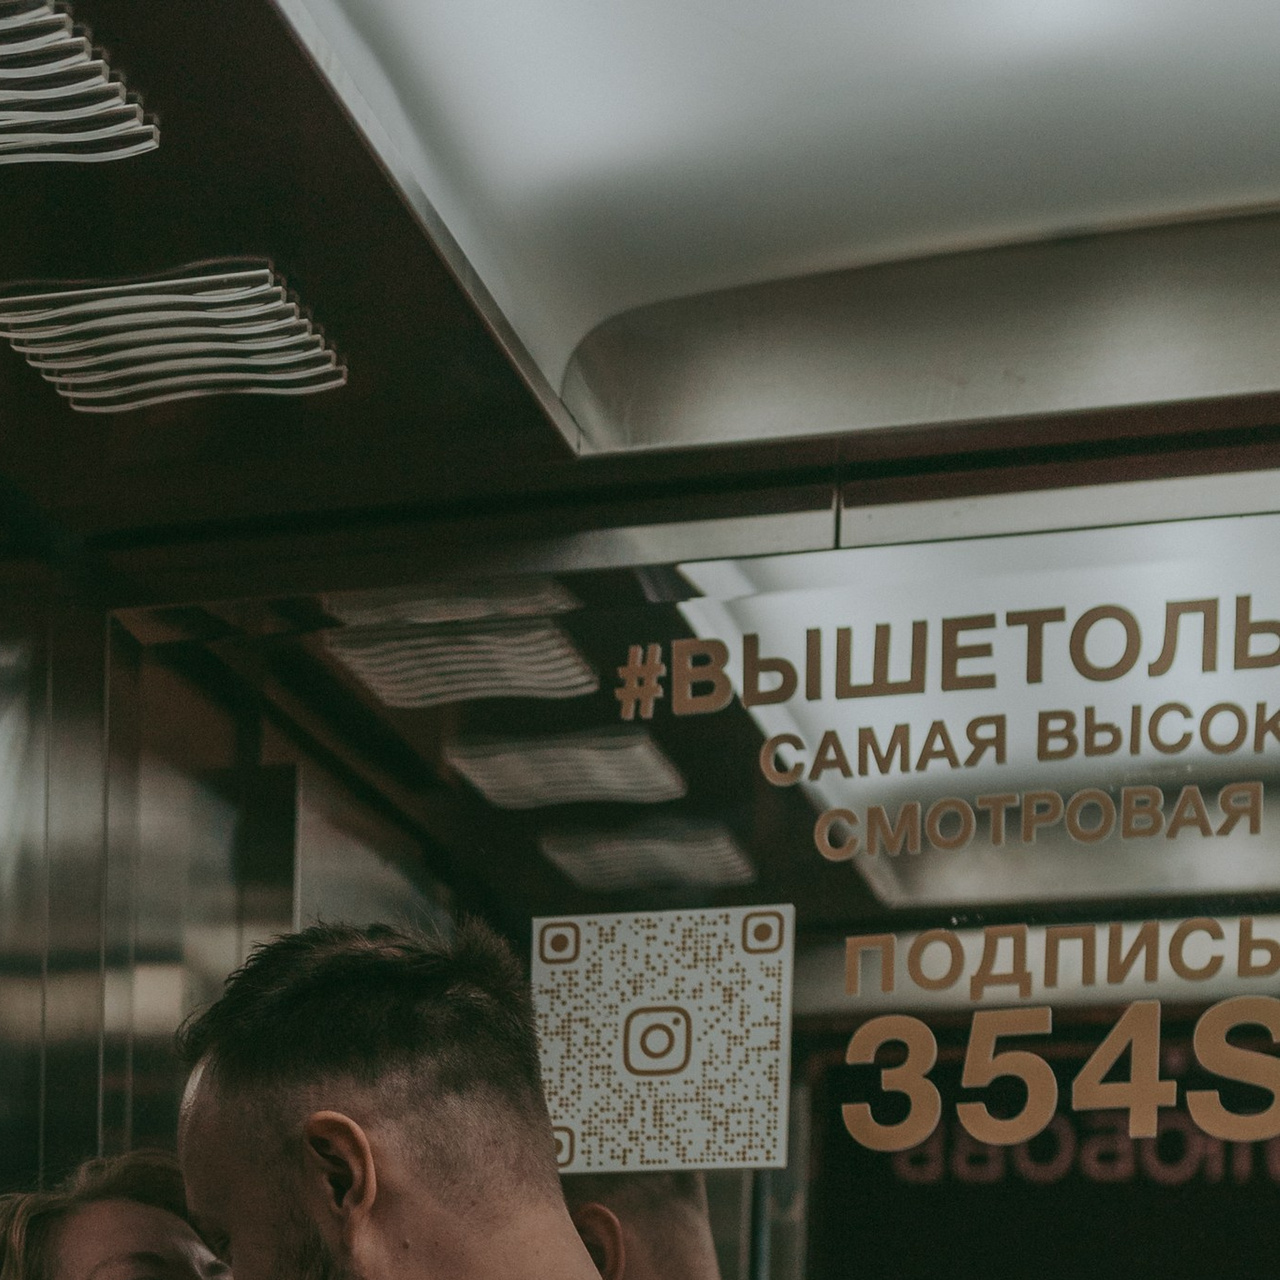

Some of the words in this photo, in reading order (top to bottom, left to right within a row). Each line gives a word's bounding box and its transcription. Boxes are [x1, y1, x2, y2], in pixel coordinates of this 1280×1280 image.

[616, 594, 1280, 720] #ВЫШЕТОЛЬ
[759, 715, 1008, 786] САМАЯ
[815, 781, 1265, 862] СМОТРОВАЯ
[841, 995, 1280, 1152] 354S
